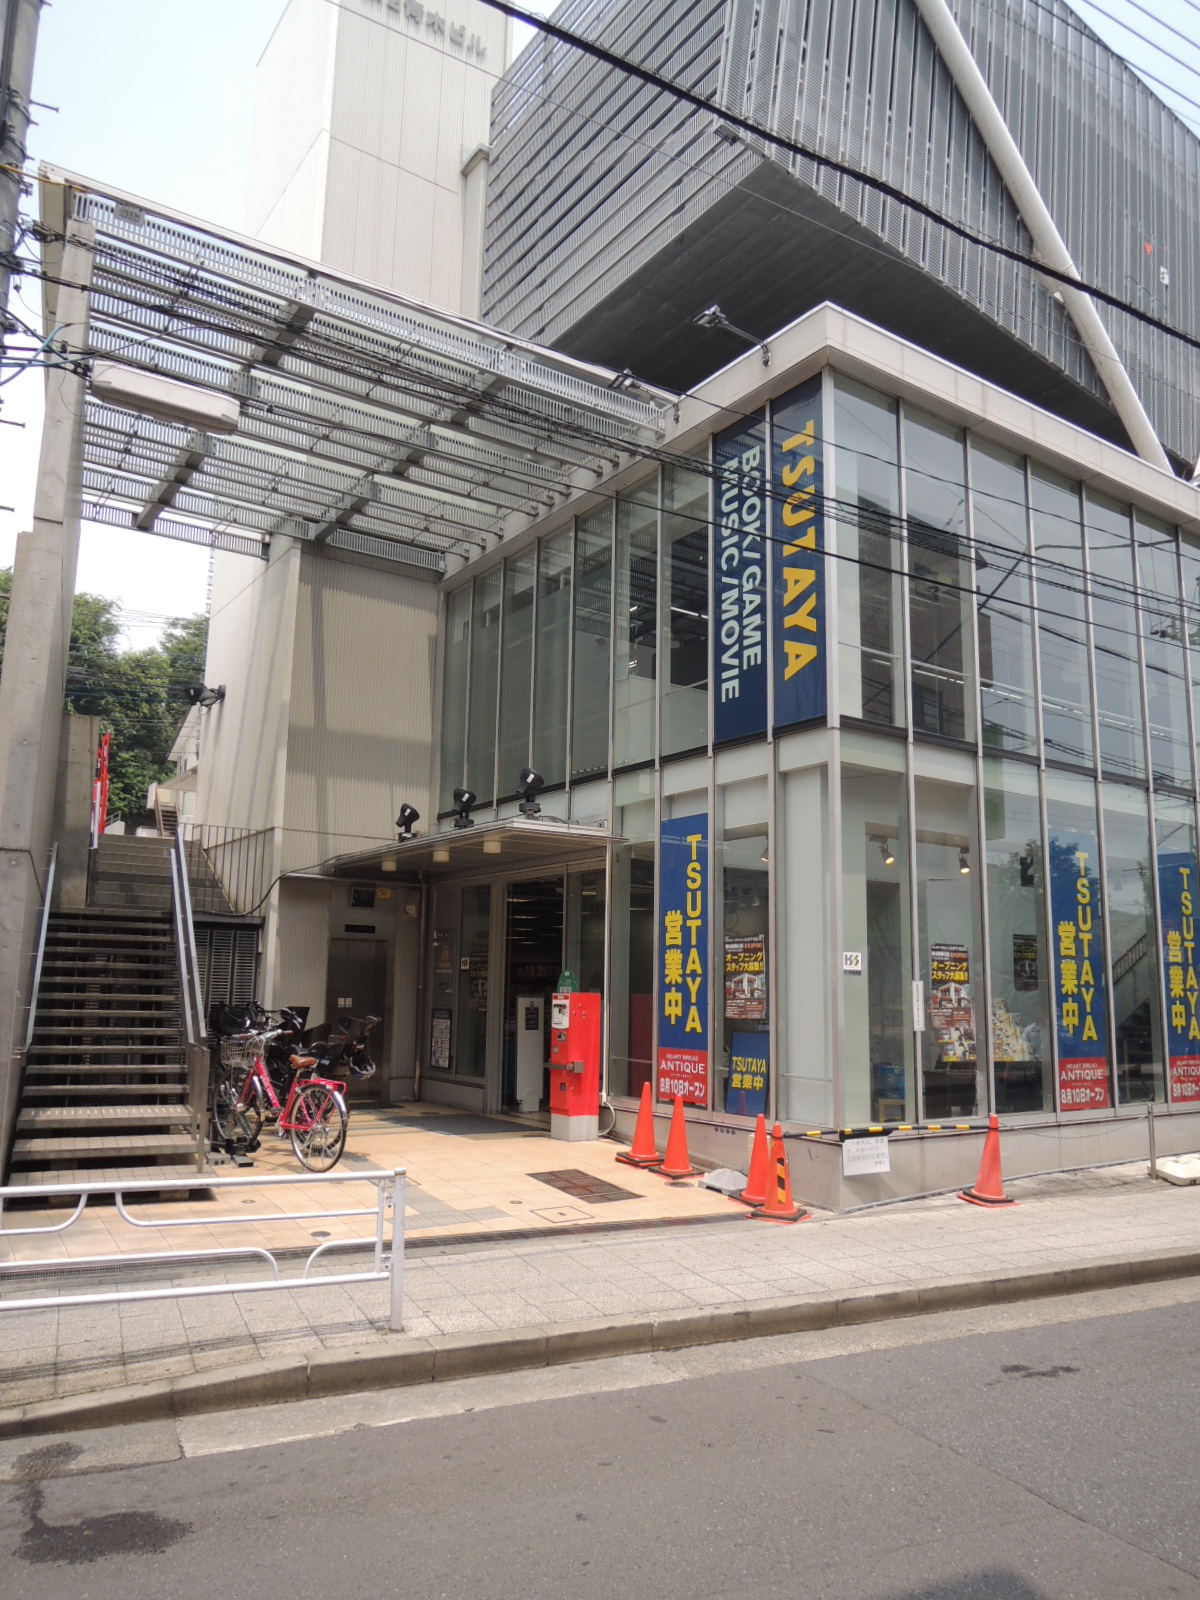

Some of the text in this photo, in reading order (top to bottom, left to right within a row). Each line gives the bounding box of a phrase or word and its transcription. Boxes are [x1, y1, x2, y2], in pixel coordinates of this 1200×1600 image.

[781, 418, 818, 682] TSUTAYA
[665, 910, 683, 1025] 営業中
[685, 834, 702, 1033] TSUTAYA
[1058, 921, 1079, 1034] 営業中
[1075, 852, 1098, 1041] TSUTAYA
[1166, 930, 1187, 1034] 営業中
[1178, 866, 1200, 1041] TSUTAYA
[660, 1060, 706, 1075] ANTIQUE
[731, 1074, 764, 1091] 営業中
[732, 1056, 766, 1074] TSUTAYA
[1060, 1069, 1104, 1081] ANTIQUE
